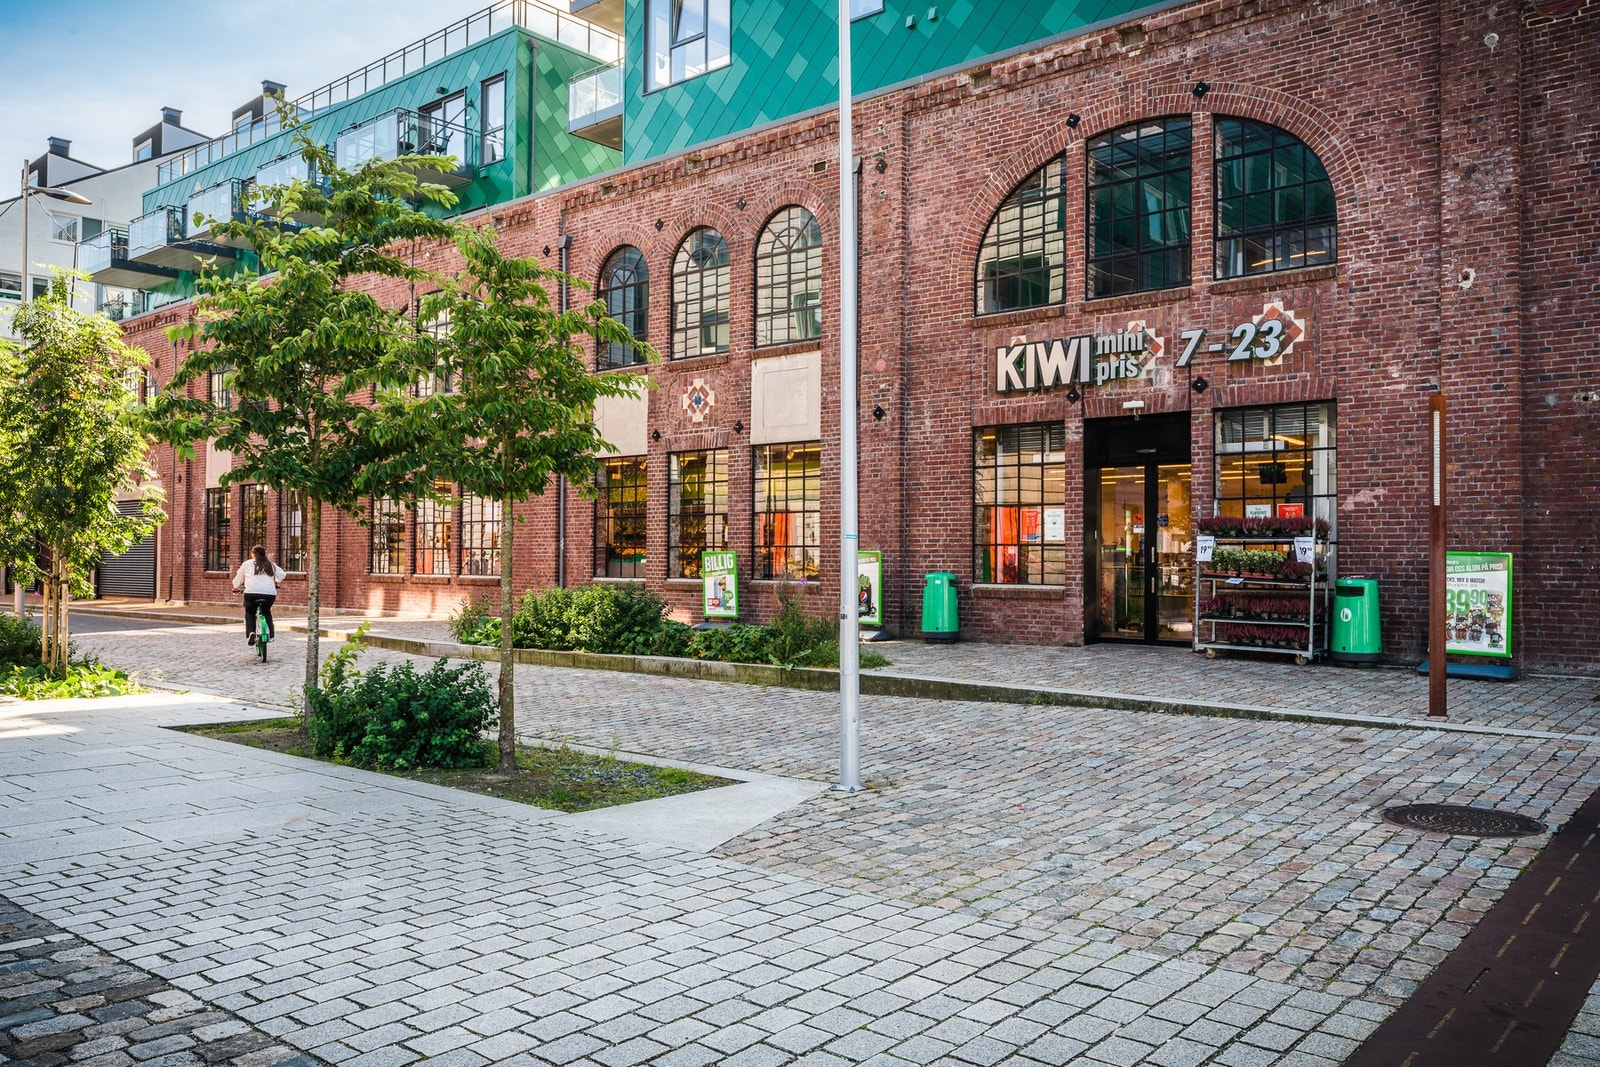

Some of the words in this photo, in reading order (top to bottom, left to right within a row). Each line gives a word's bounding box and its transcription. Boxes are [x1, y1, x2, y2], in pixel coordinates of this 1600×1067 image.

[1096, 327, 1144, 355] mini
[996, 336, 1093, 393] KIWI
[1096, 357, 1139, 386] pris
[704, 554, 733, 572] BILLIG
